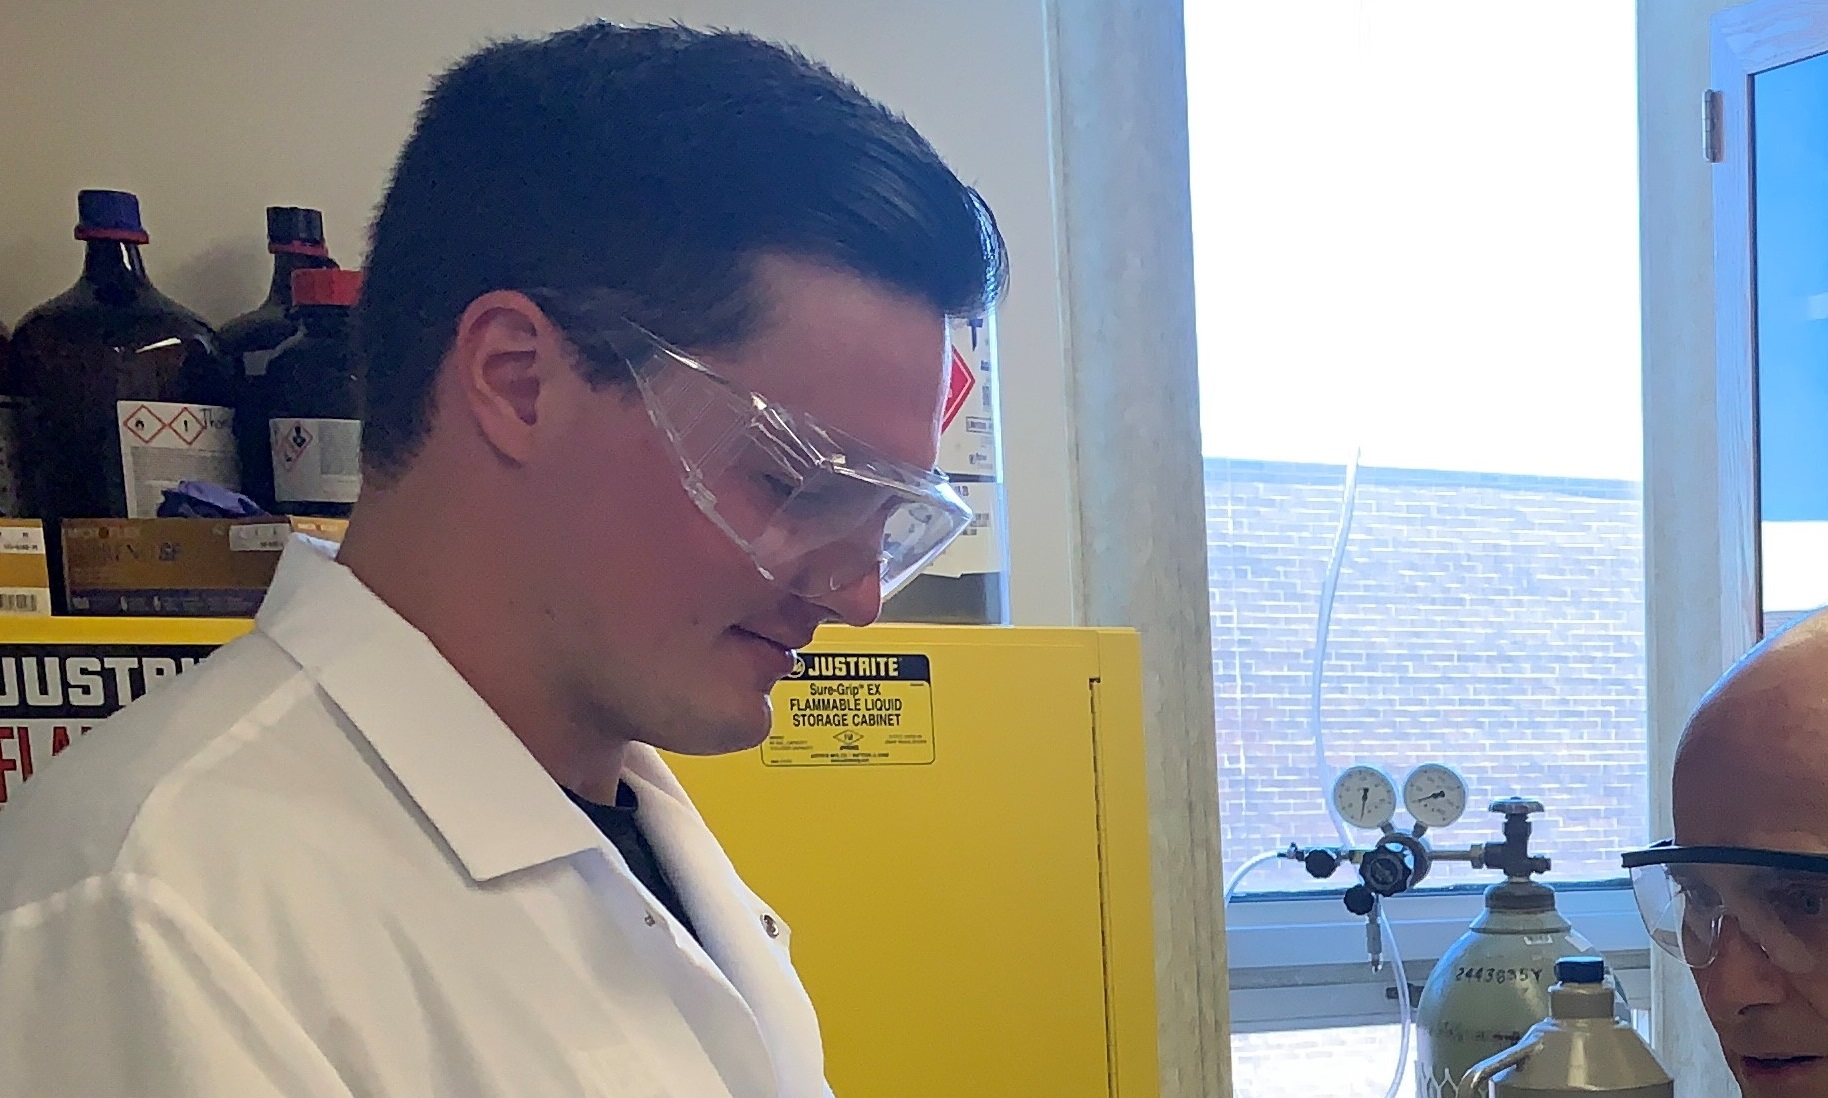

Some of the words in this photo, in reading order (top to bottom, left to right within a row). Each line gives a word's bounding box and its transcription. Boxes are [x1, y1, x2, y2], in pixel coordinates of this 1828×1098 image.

[807, 656, 900, 677] JUSTRITE
[0, 656, 210, 707] JUSTR
[867, 683, 881, 696] EX
[789, 698, 862, 712] FLAMMABLE
[864, 698, 903, 712] LIQUID
[792, 713, 849, 728] STORAGE
[852, 713, 901, 727] CABINET
